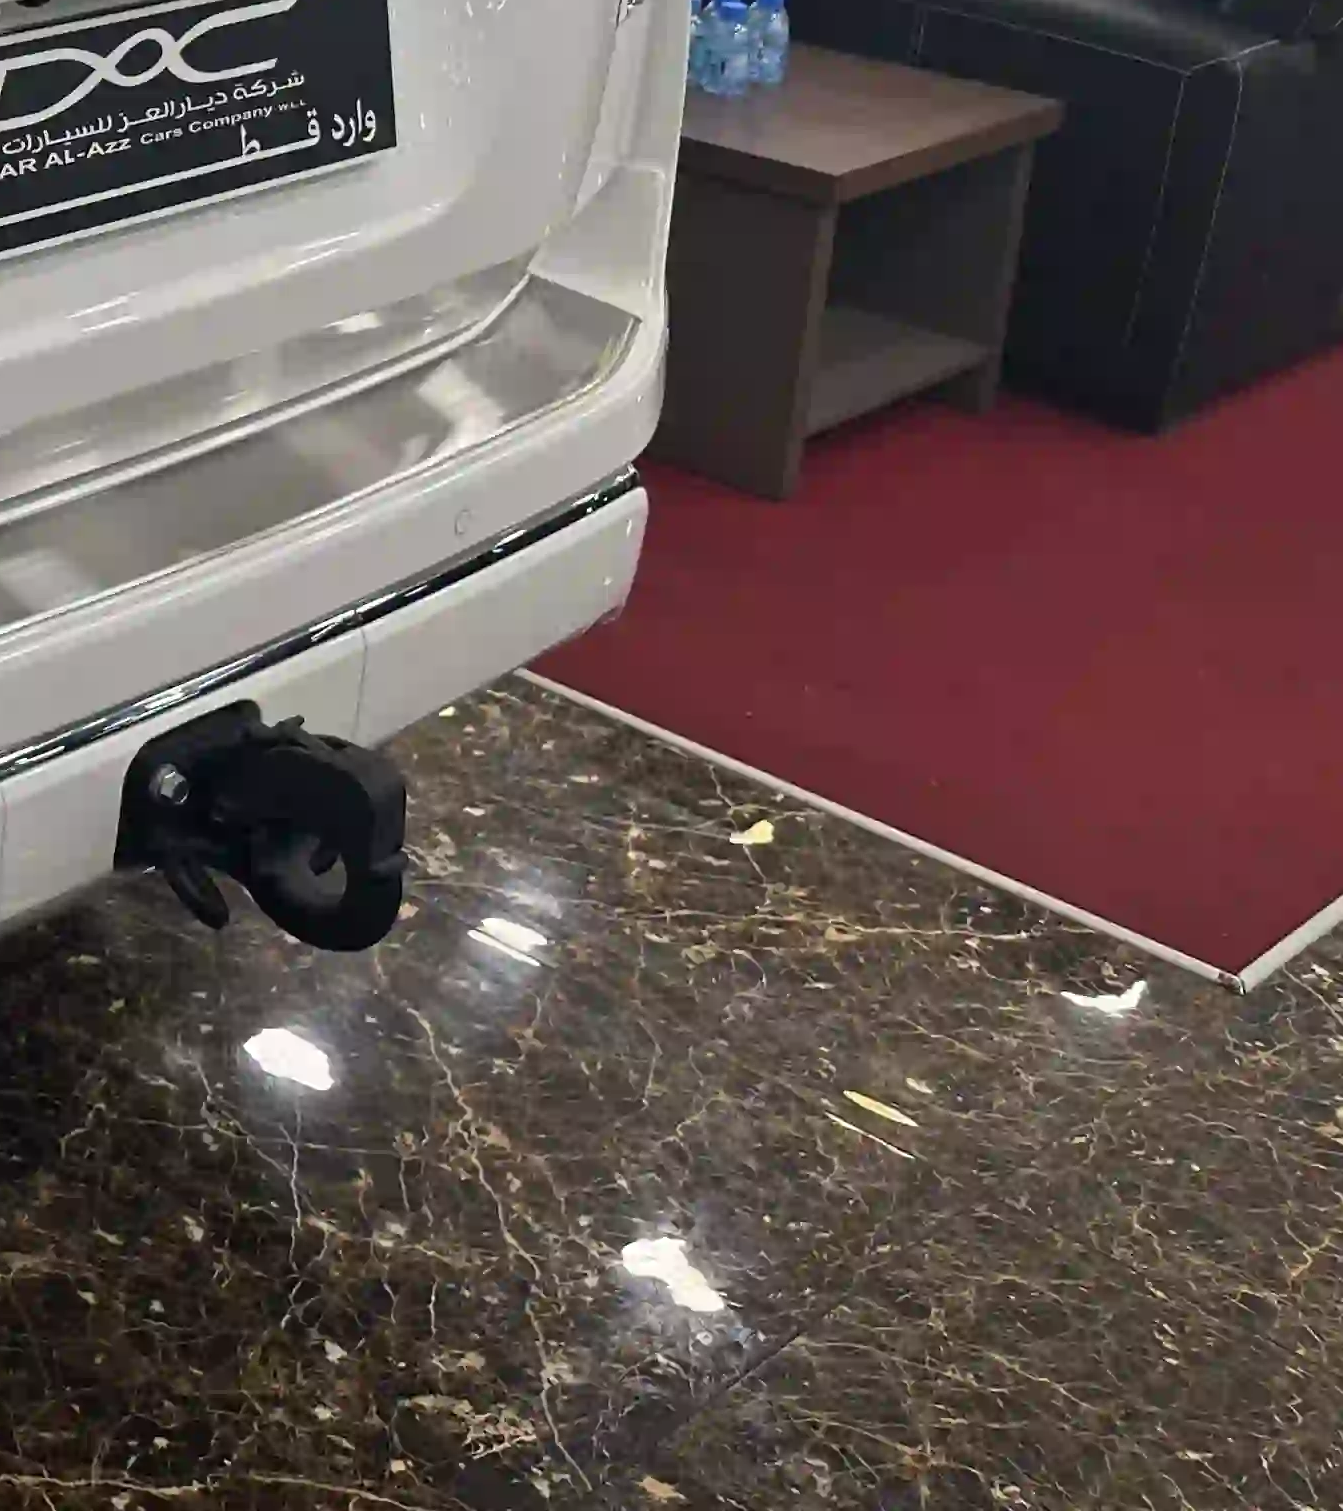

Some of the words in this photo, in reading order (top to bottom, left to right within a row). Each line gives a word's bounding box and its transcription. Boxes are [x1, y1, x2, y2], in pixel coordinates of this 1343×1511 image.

[233, 70, 305, 102] شركة
[1, 114, 113, 155] للسيارات
[139, 126, 183, 145] Cars
[188, 101, 273, 134] Company
[330, 97, 377, 148] وارد
